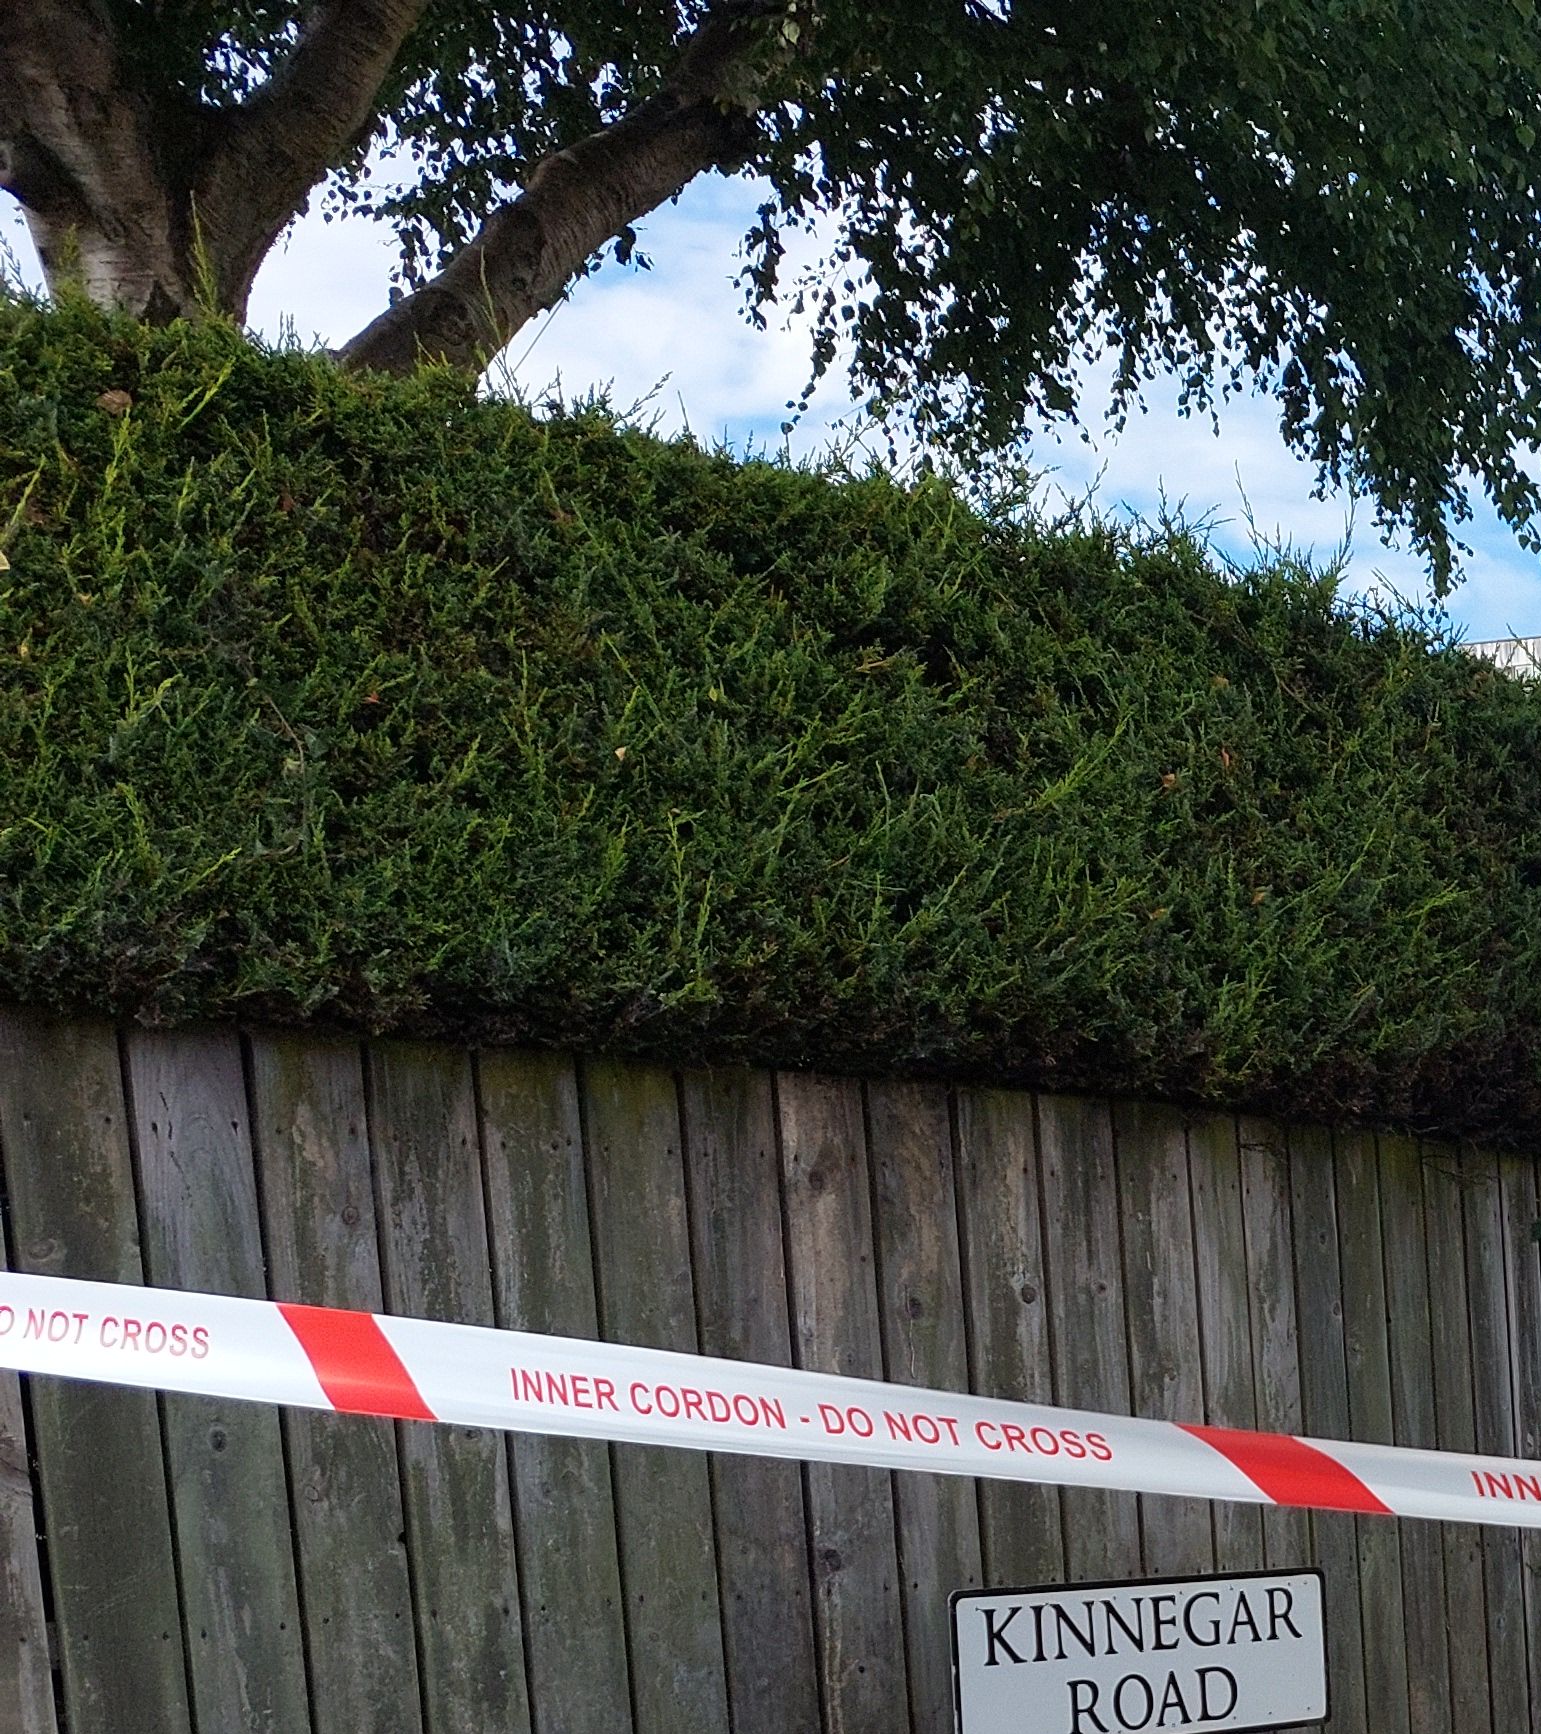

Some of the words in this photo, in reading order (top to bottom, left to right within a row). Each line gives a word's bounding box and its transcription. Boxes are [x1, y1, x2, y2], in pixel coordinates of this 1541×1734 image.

[23, 1307, 90, 1345] NOT
[100, 1315, 210, 1360] CROSS
[511, 1368, 618, 1411] INNER
[629, 1381, 787, 1430] CORDON
[818, 1403, 875, 1438] DO
[884, 1411, 960, 1446] NOT
[975, 1420, 1114, 1462] CROSS
[976, 1586, 1303, 1667] KINNEGAR
